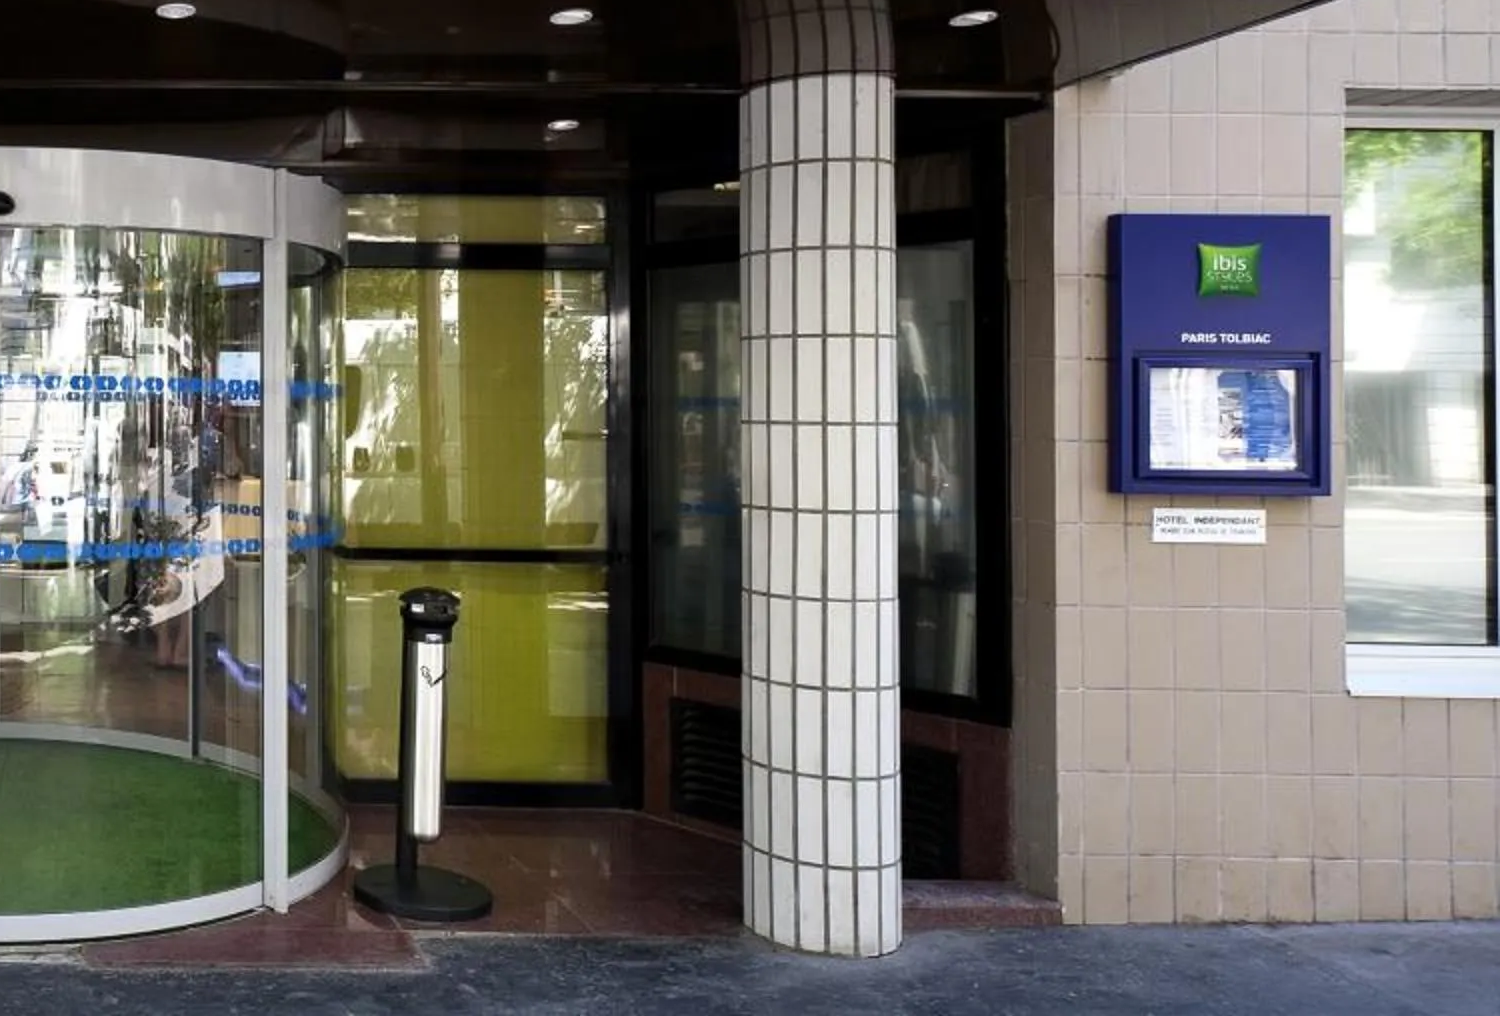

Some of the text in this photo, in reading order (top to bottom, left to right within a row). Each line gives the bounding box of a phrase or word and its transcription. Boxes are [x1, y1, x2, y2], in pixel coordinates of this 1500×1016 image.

[1213, 253, 1248, 272] ibis
[1181, 332, 1272, 345] PARIS TOLBIAC
